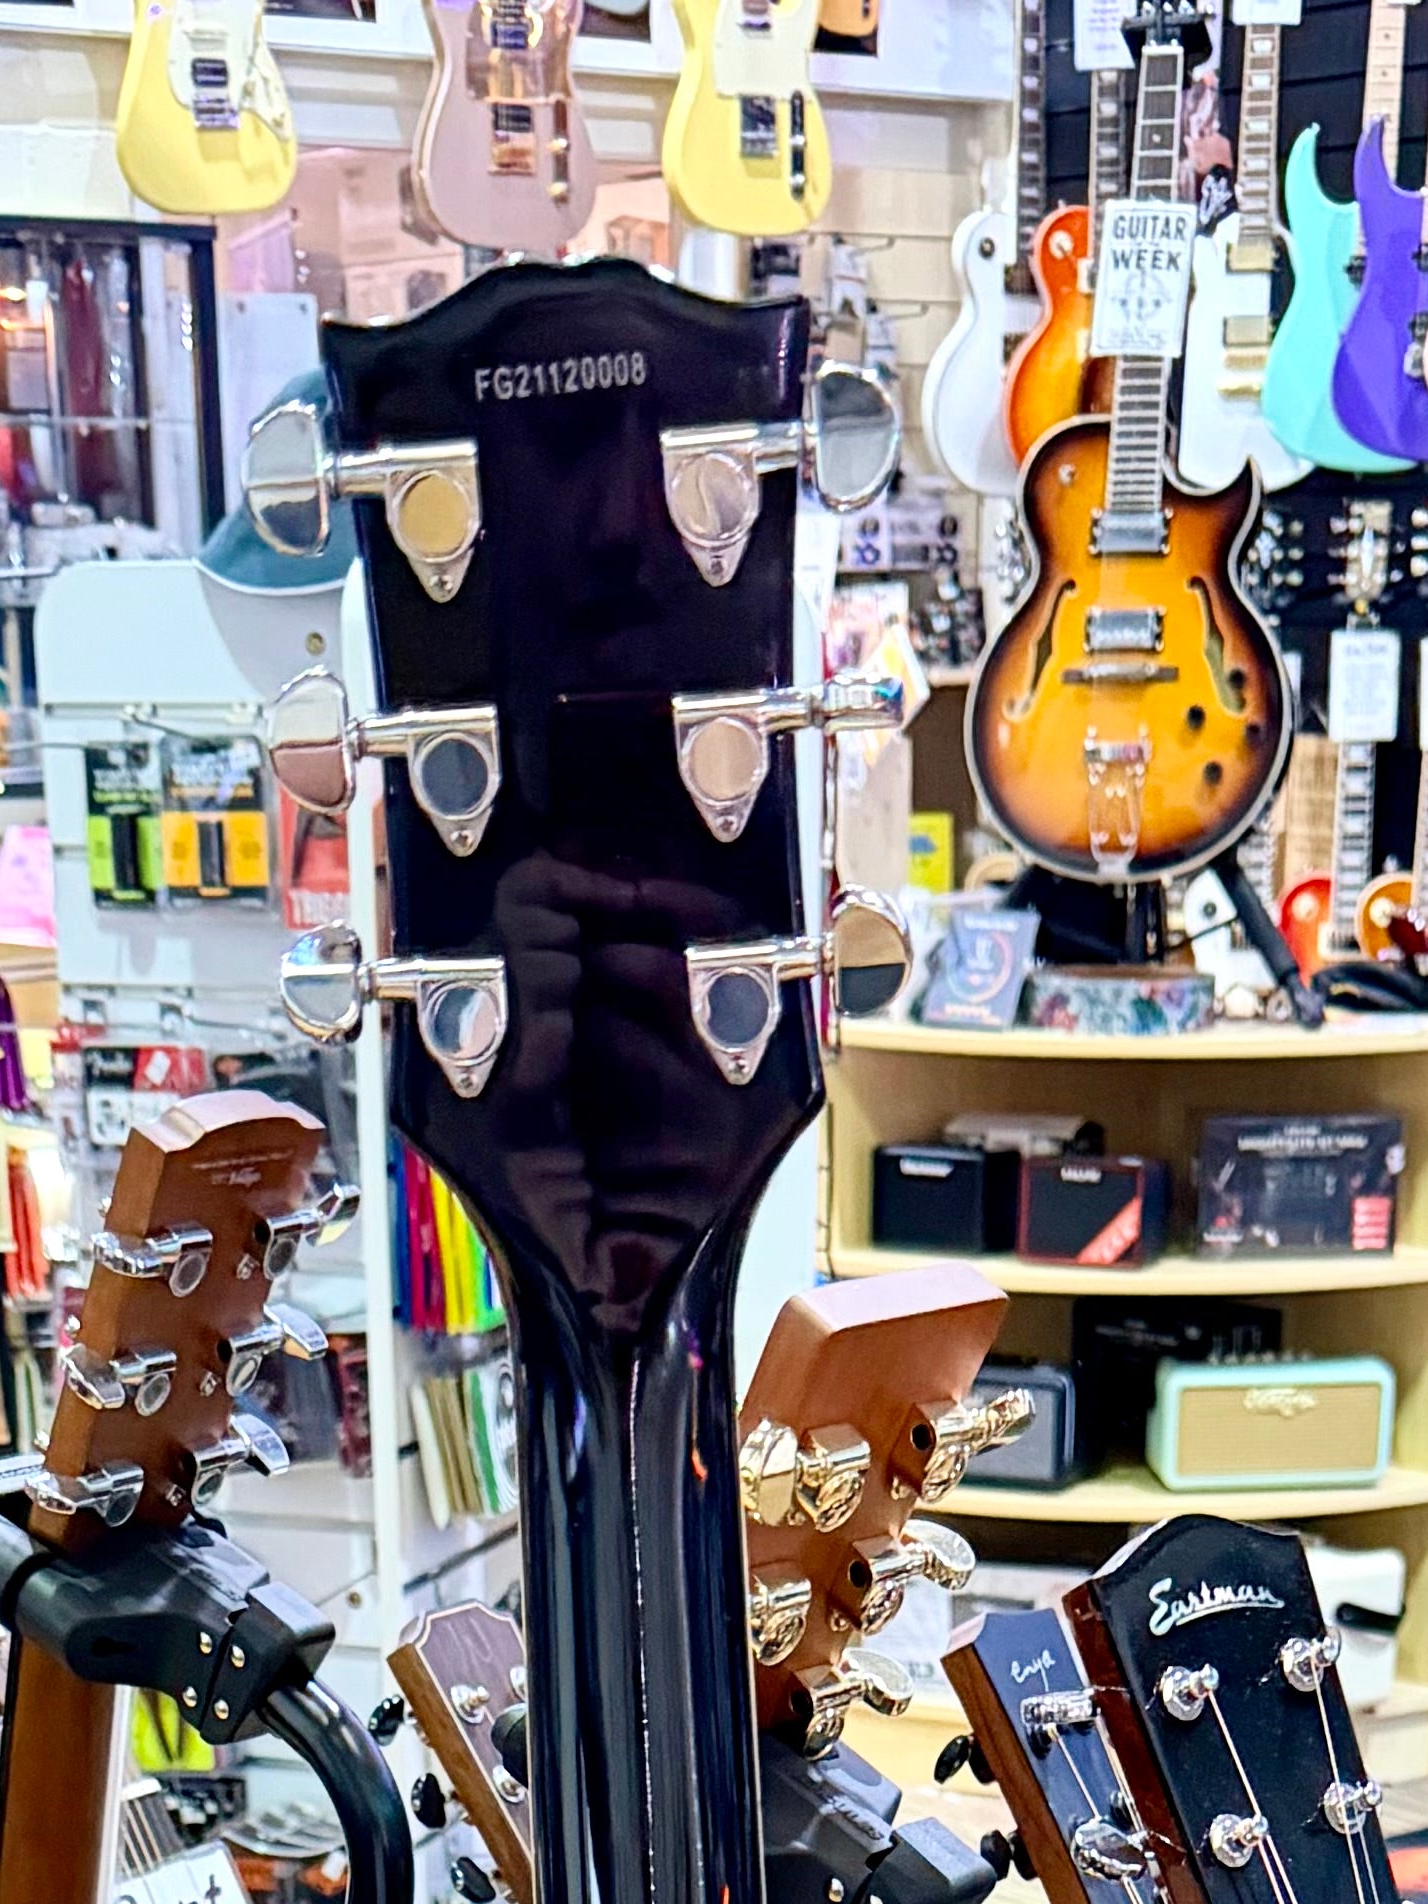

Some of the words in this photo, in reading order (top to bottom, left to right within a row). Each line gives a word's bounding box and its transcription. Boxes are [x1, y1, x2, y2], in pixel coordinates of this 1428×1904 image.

[1113, 214, 1187, 241] GUITAR
[1111, 248, 1182, 272] WEEK
[474, 351, 647, 401] FG21120008
[1148, 1577, 1285, 1637] Eastman
